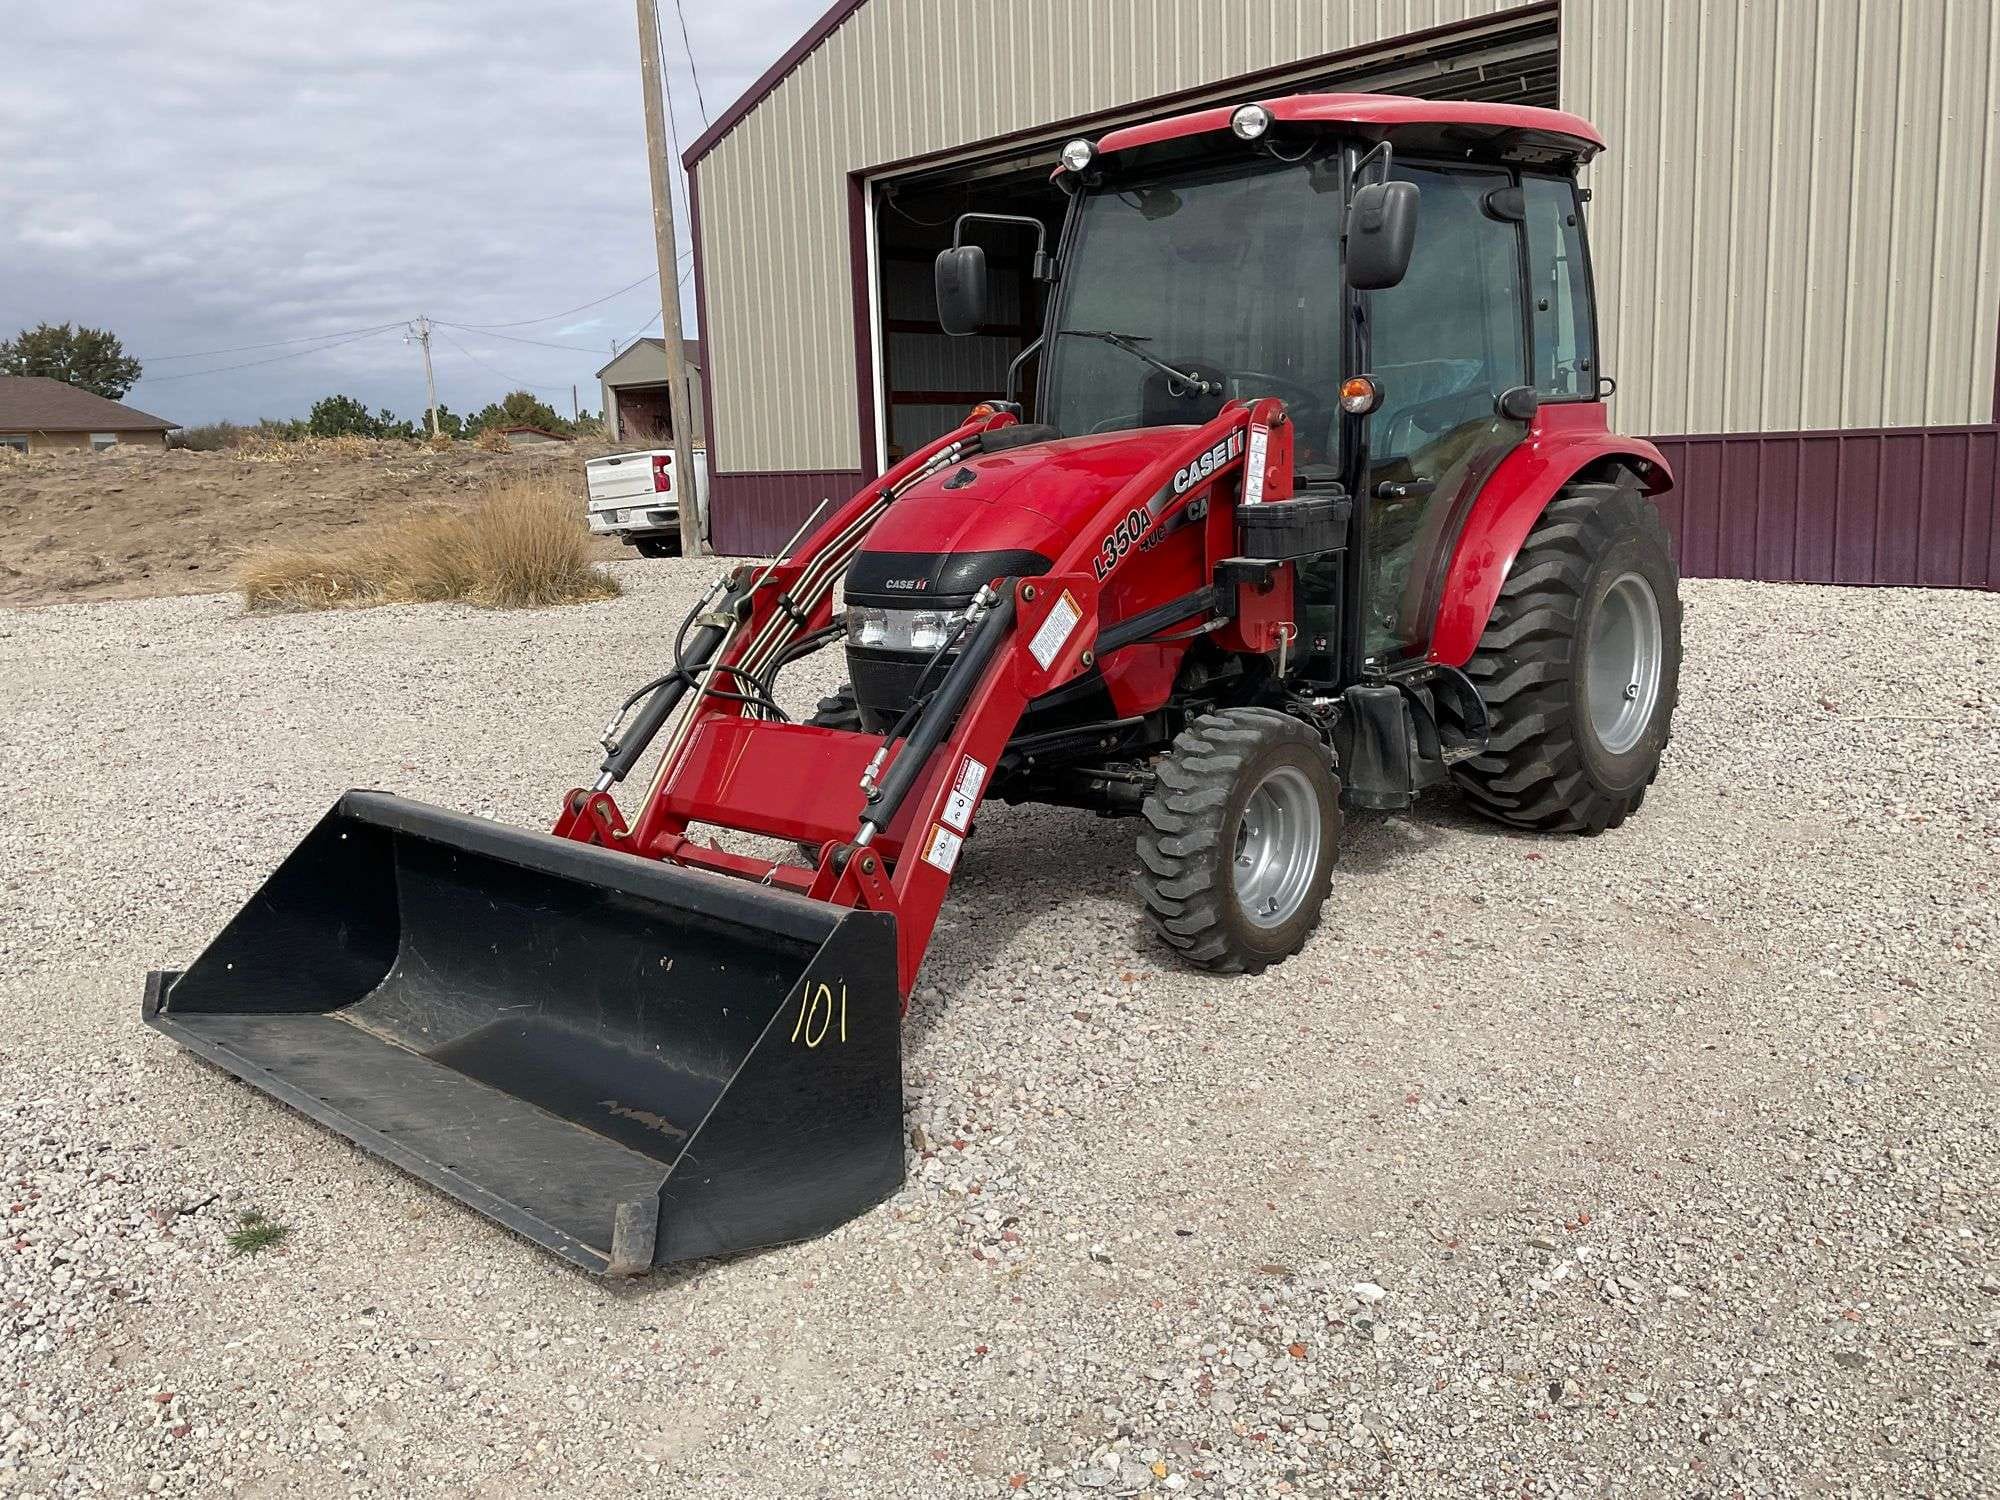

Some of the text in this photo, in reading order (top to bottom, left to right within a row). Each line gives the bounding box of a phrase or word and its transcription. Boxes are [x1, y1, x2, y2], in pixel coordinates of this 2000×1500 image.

[1173, 442, 1227, 494] CASE
[1187, 498, 1208, 521] CA
[1092, 507, 1153, 583] L350A
[885, 579, 915, 590] CASE
[791, 980, 847, 1048] 101
